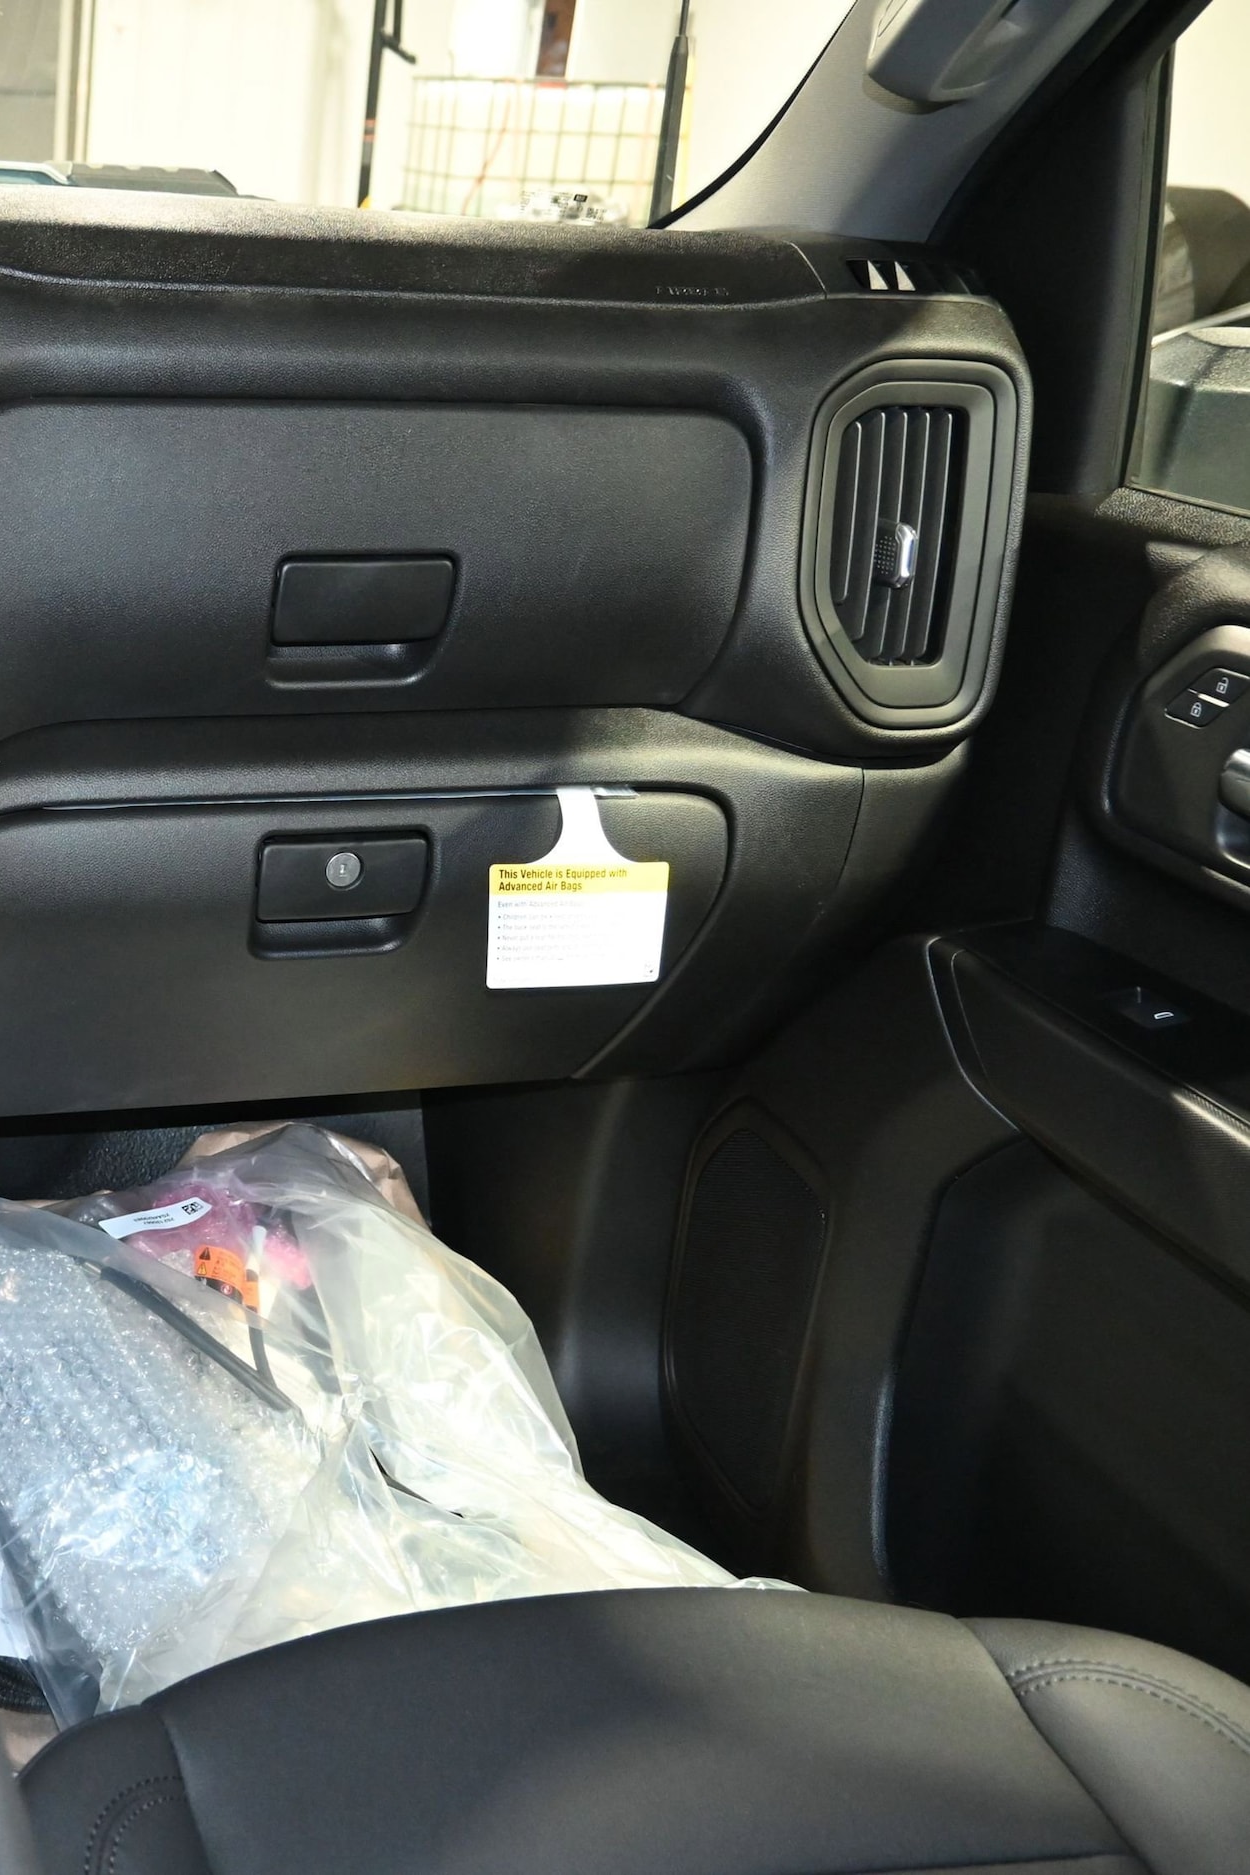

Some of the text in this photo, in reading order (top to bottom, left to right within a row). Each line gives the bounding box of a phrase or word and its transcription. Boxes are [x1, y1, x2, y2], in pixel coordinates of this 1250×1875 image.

[498, 868, 627, 879] This Vehicle is Equipped with
[498, 880, 583, 892] Advanced Air Bags
